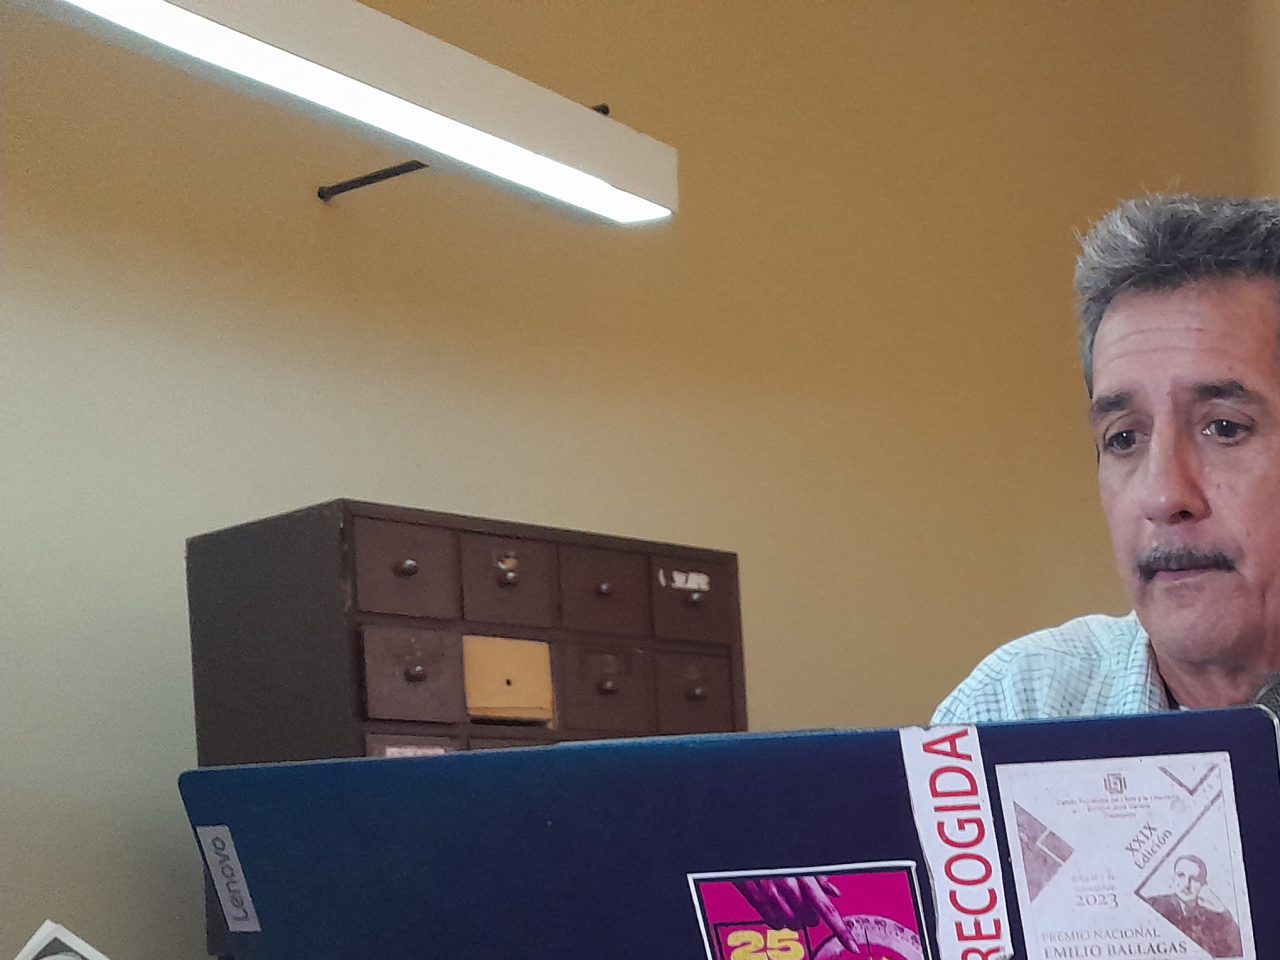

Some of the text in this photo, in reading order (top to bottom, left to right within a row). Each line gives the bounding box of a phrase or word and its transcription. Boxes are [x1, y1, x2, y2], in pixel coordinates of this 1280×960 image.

[1125, 821, 1158, 859] XXIX
[1134, 829, 1174, 870] Edición
[211, 835, 251, 922] Lenovo
[1075, 892, 1119, 909] 2023
[1042, 925, 1161, 943] PREMIO NACIONAL
[1044, 941, 1188, 960] EMILIO BALLAGAS
